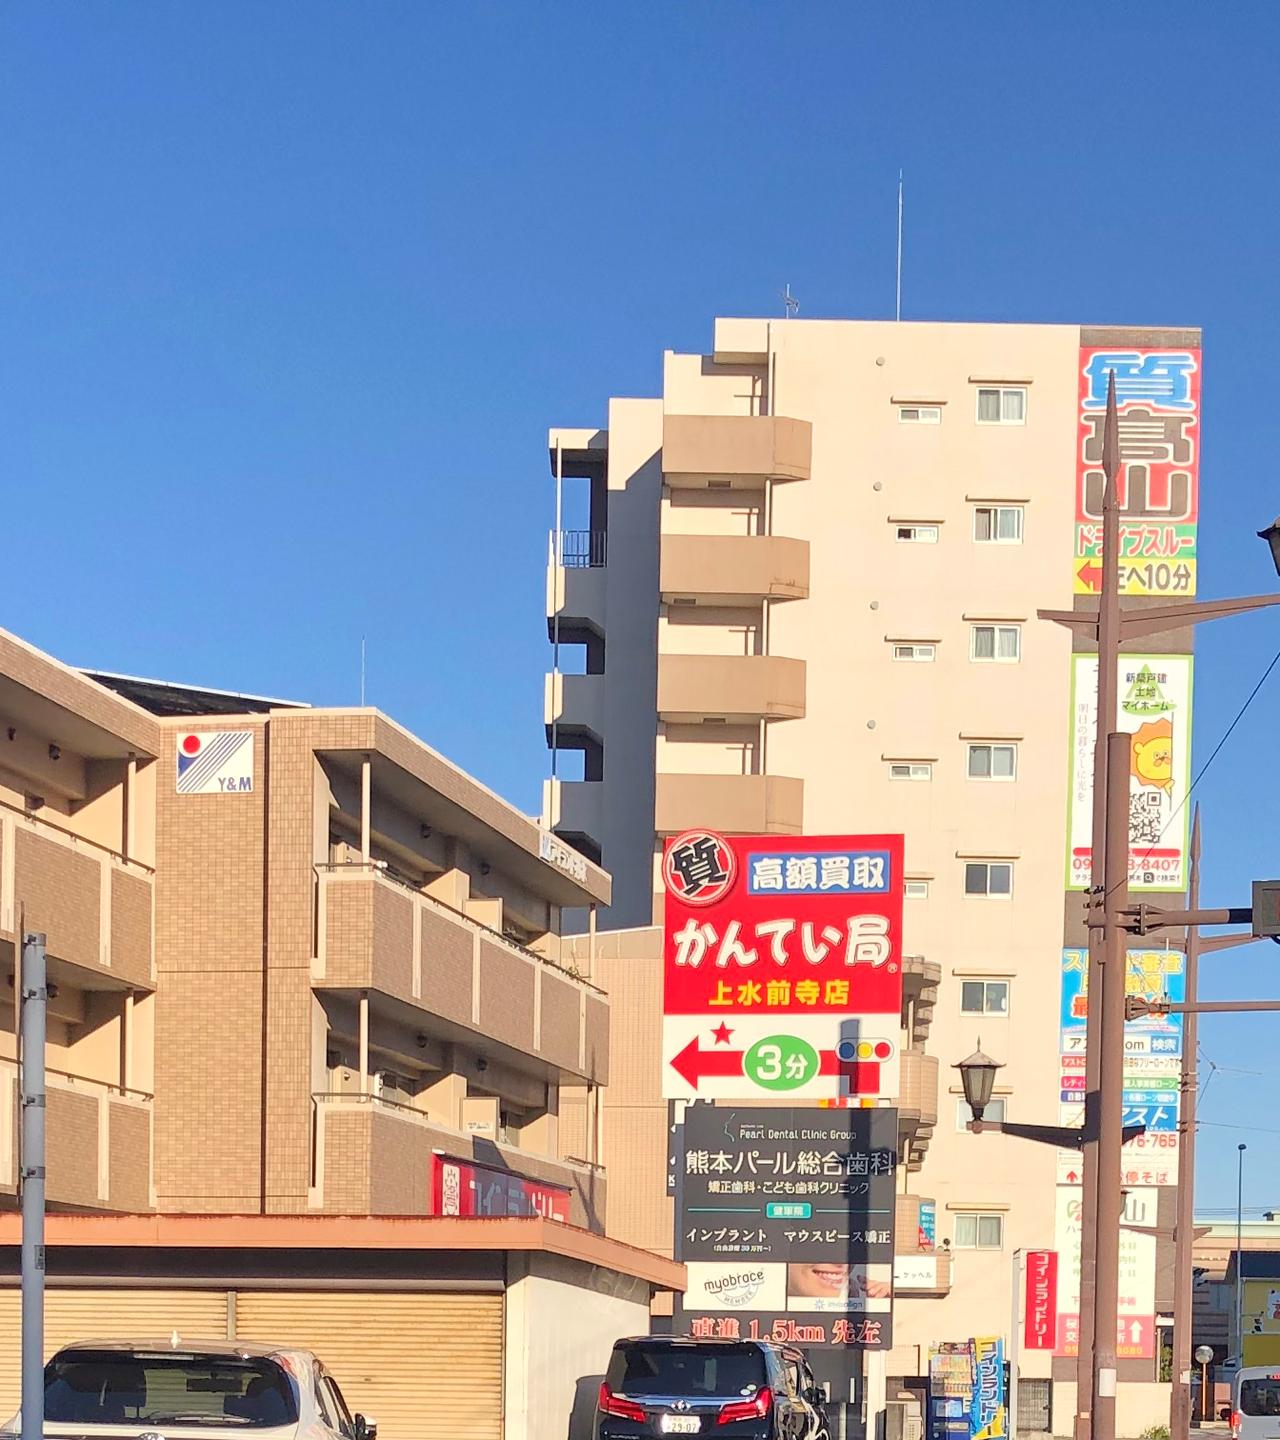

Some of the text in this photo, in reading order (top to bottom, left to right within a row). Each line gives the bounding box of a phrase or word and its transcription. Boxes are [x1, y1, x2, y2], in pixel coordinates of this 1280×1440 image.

[1125, 672, 1168, 684] 新築戸建
[1135, 687, 1156, 698] 土地
[1121, 700, 1169, 711] マイホーム
[218, 776, 252, 791] Y&M
[752, 856, 885, 891] 高額買取
[672, 914, 891, 968] かんてい局
[708, 979, 850, 1007] 上水前寺店
[756, 1044, 809, 1081] 3分
[739, 1129, 857, 1142] Pearl Dental Clinic Group
[685, 1150, 895, 1176] 熊本パール総合歯科
[707, 1180, 870, 1195] 矯正歯科・こども歯科クリニック
[685, 1227, 892, 1245] インプラント マウスピース矯正
[703, 1270, 765, 1294] myobrace
[1033, 1253, 1049, 1347] コインランドリー
[691, 1317, 882, 1344] 直進 1.5km 先左
